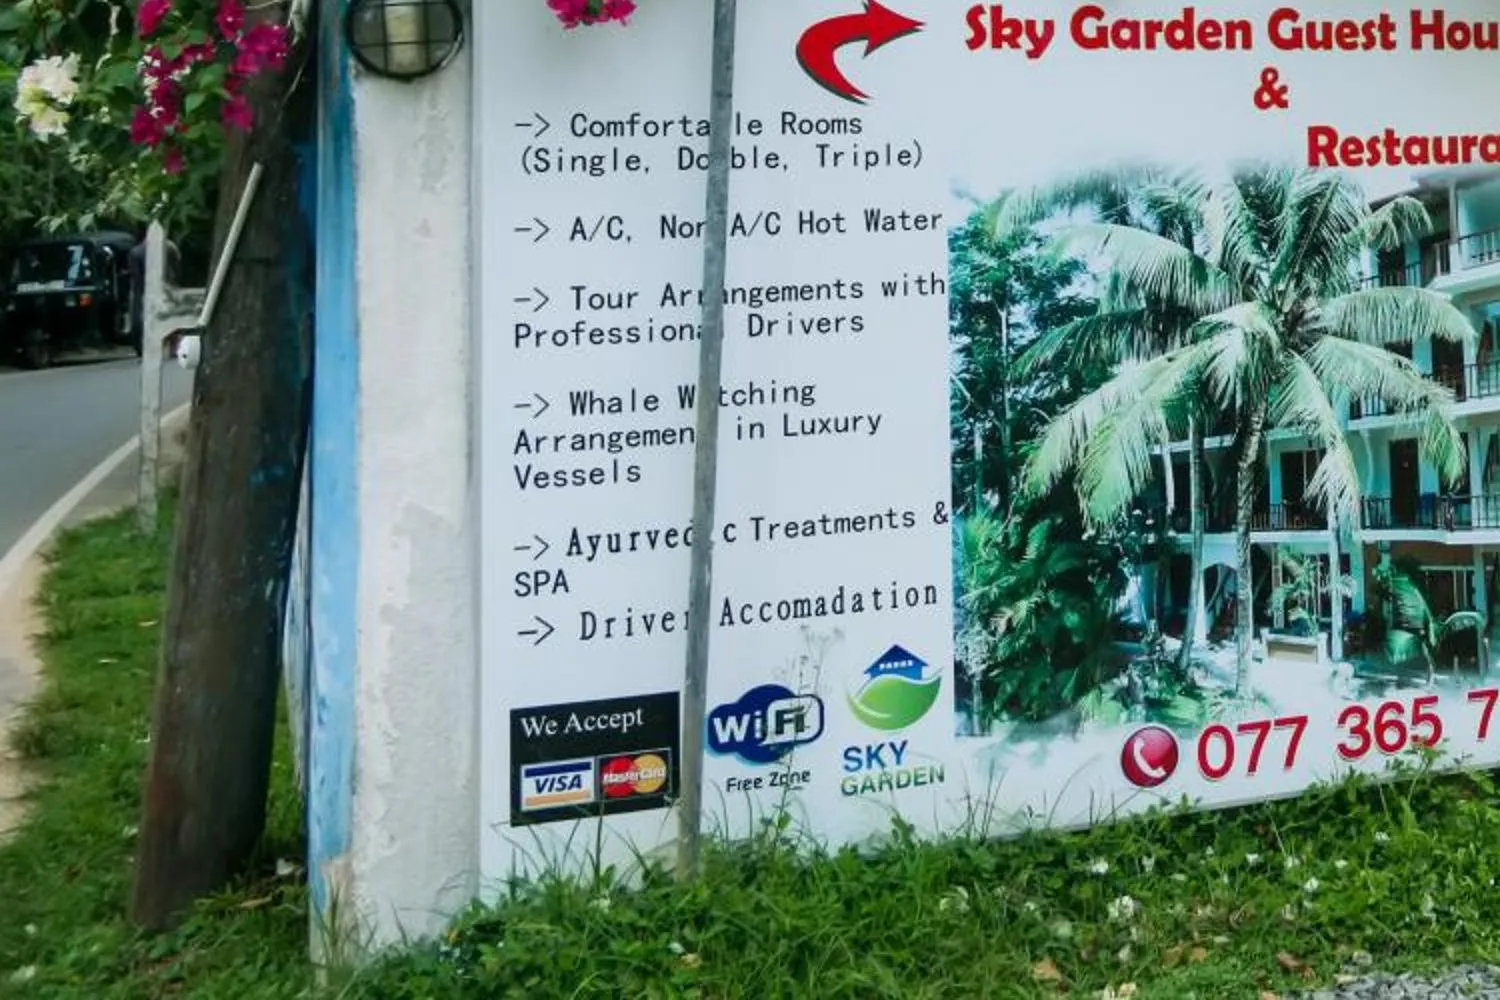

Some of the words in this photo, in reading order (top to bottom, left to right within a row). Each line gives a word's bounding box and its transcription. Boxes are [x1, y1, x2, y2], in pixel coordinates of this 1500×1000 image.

[964, 4, 1055, 59] Sky
[1069, 3, 1253, 51] Garden
[1267, 7, 1398, 51] Guest
[1252, 66, 1289, 110] &
[570, 111, 763, 138] Comfortale
[781, 110, 863, 135] Rooms
[521, 145, 651, 176] (Single,
[677, 143, 789, 172] Doble,
[815, 139, 925, 170] Triple)
[570, 214, 632, 242] A/C,
[730, 211, 782, 237] A/C
[799, 211, 847, 235] Hot
[863, 208, 943, 232] Water
[571, 285, 639, 311] Tour
[882, 273, 946, 297] with
[514, 317, 705, 349] Profession
[748, 311, 865, 338] Drivers
[569, 388, 660, 416] Whale
[677, 379, 816, 409] Wtching
[514, 425, 698, 455] Arrangemen
[737, 414, 765, 440] in
[783, 411, 882, 437] Luxury
[514, 459, 642, 490] Vessels
[566, 519, 738, 560] Ayurvedc
[750, 506, 916, 542] Treatments
[932, 501, 949, 526] &
[513, 568, 570, 598] SPA
[719, 581, 938, 627] Accomadation
[520, 714, 558, 738] We
[564, 708, 645, 734] Accept
[713, 705, 806, 744] WiFi
[1197, 714, 1309, 781] 077
[1336, 695, 1443, 760] 365
[842, 739, 909, 773] SKY
[534, 773, 583, 795] VISA
[726, 776, 763, 794] Free
[769, 768, 811, 788] Zone
[841, 764, 946, 797] GARDEN
